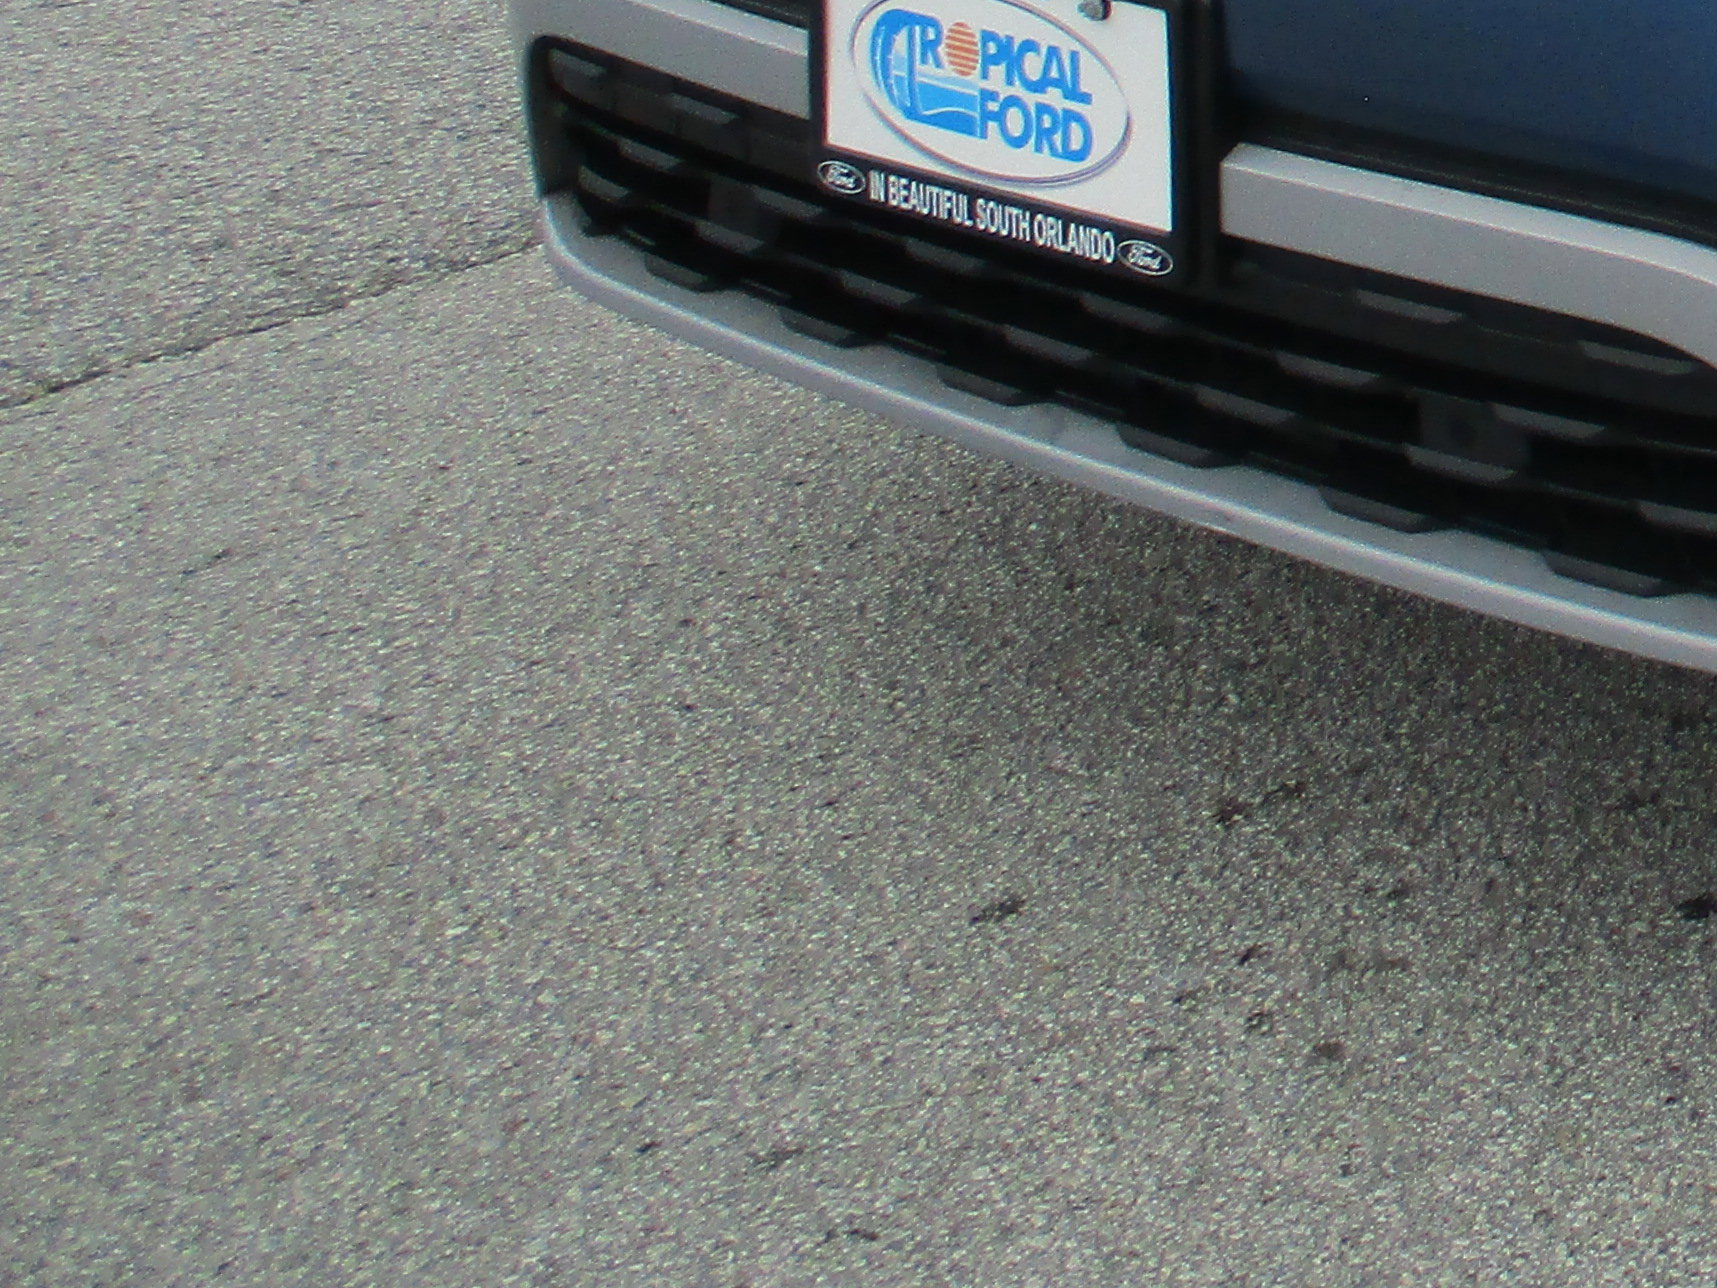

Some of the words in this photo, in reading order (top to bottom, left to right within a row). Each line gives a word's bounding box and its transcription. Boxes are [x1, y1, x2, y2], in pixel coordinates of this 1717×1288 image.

[978, 88, 1093, 163] FORD
[868, 169, 886, 203] IN
[887, 172, 975, 227] BEAUTIFUL
[975, 196, 1032, 242] SOUTH
[1033, 212, 1116, 264] ORLANDO
